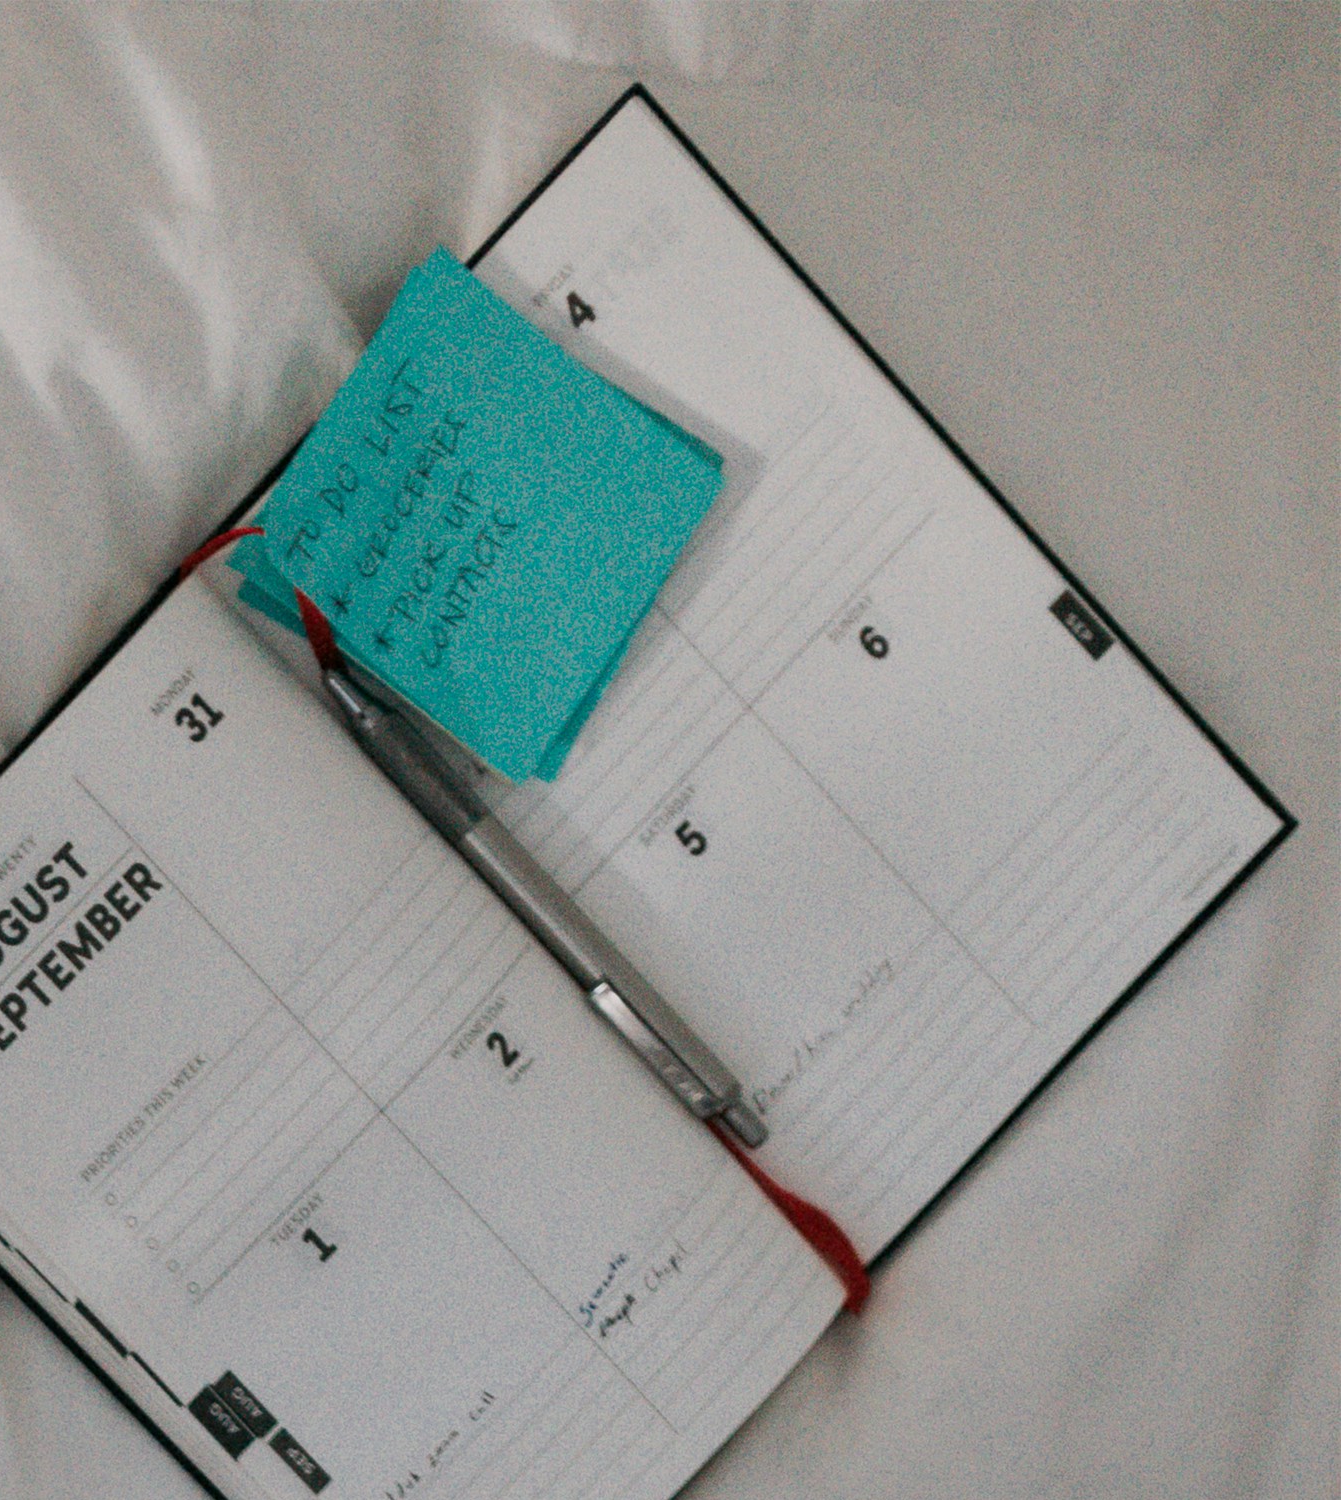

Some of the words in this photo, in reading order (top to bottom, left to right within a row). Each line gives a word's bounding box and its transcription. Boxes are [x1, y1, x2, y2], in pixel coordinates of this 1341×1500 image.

[566, 292, 596, 329] 4
[281, 518, 321, 561] TO
[318, 463, 364, 518] DO
[361, 357, 422, 459] LIST
[356, 415, 467, 582] GROCERIES
[387, 542, 447, 622] PICK
[440, 469, 477, 532] UP
[422, 513, 520, 669] CONTACTS
[859, 626, 889, 660] 6
[150, 667, 196, 716] MONDAY
[174, 693, 225, 743] 31
[639, 785, 696, 847] SATURDAY
[674, 820, 707, 857] 5
[449, 995, 507, 1060] WEDNESDAY
[486, 1031, 520, 1068] 2
[79, 1115, 147, 1183] PRIORITIES
[142, 1088, 175, 1117] THIS
[170, 1055, 206, 1090] WEEK
[269, 1193, 324, 1245] TUESDAY
[301, 1227, 338, 1263] 1
[209, 1402, 240, 1434] AUG
[232, 1386, 262, 1417] AUG
